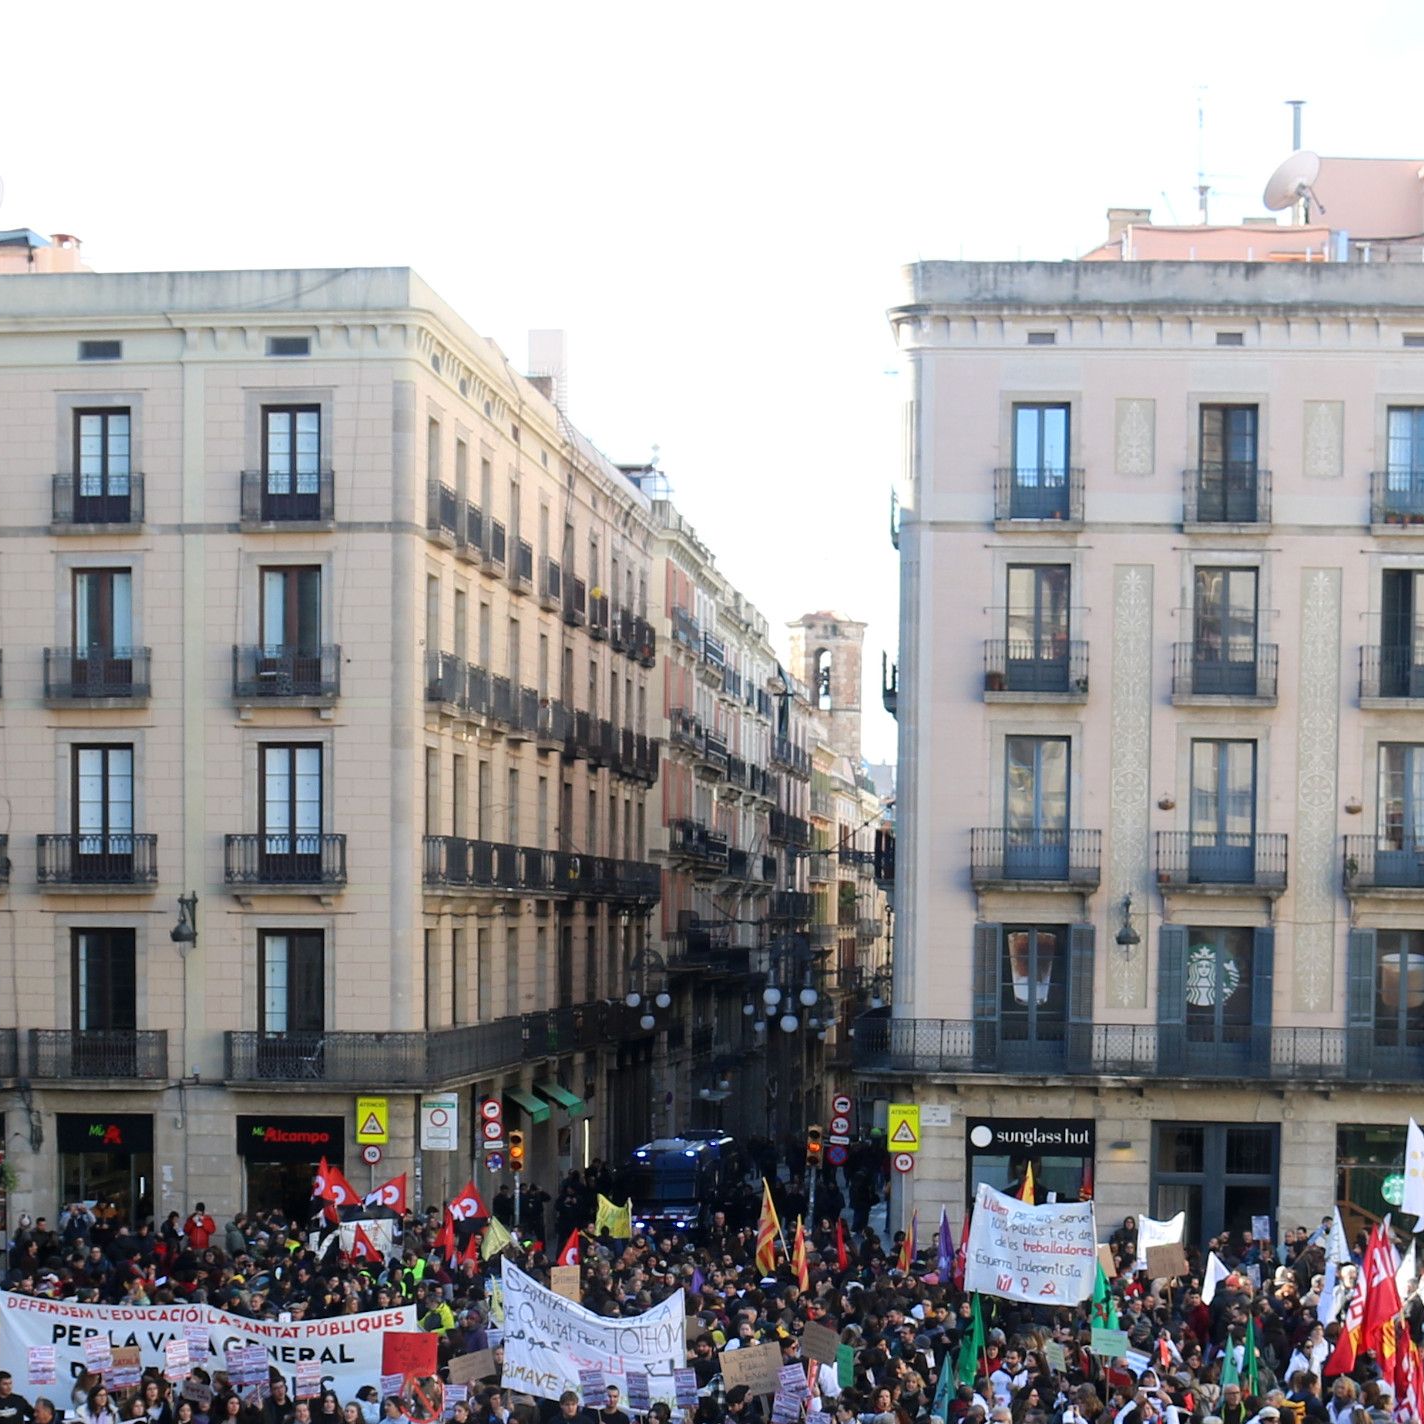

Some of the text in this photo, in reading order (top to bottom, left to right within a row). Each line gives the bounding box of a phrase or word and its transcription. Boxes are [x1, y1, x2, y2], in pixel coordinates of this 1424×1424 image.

[264, 1127, 330, 1143] Alcampo
[996, 1128, 1090, 1147] sunglass hut
[7, 1297, 93, 1319] DEFENSEM
[98, 1307, 198, 1322] L'EDUCACIÓ
[207, 1308, 227, 1325] LA
[233, 1317, 301, 1338] SANITAT
[306, 1311, 404, 1338] PÚBLIQUES
